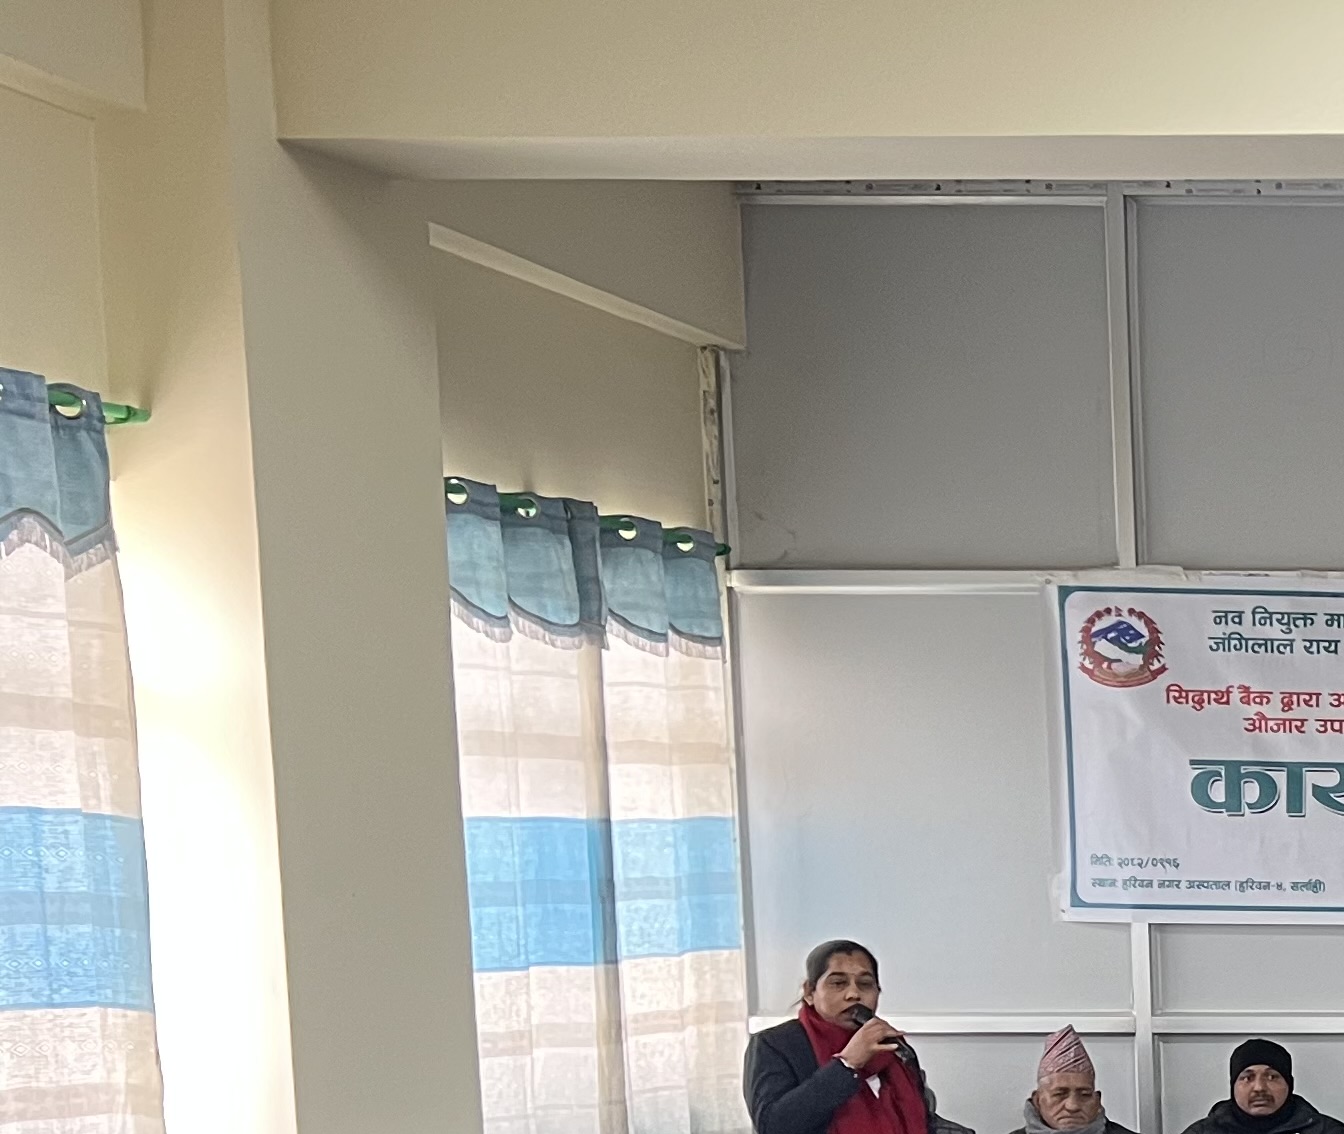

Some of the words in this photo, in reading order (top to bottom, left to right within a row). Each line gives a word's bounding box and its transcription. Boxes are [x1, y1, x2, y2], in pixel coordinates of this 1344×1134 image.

[1212, 608, 1246, 627] नव
[1250, 605, 1318, 635] नियुक्त
[1207, 631, 1296, 655] जंगिलाल
[1302, 638, 1341, 656] राय
[1236, 683, 1275, 707] बैंक
[1278, 690, 1322, 713] द्वारा
[1157, 879, 1182, 890] नगर
[1185, 880, 1231, 892] अस्पताल
